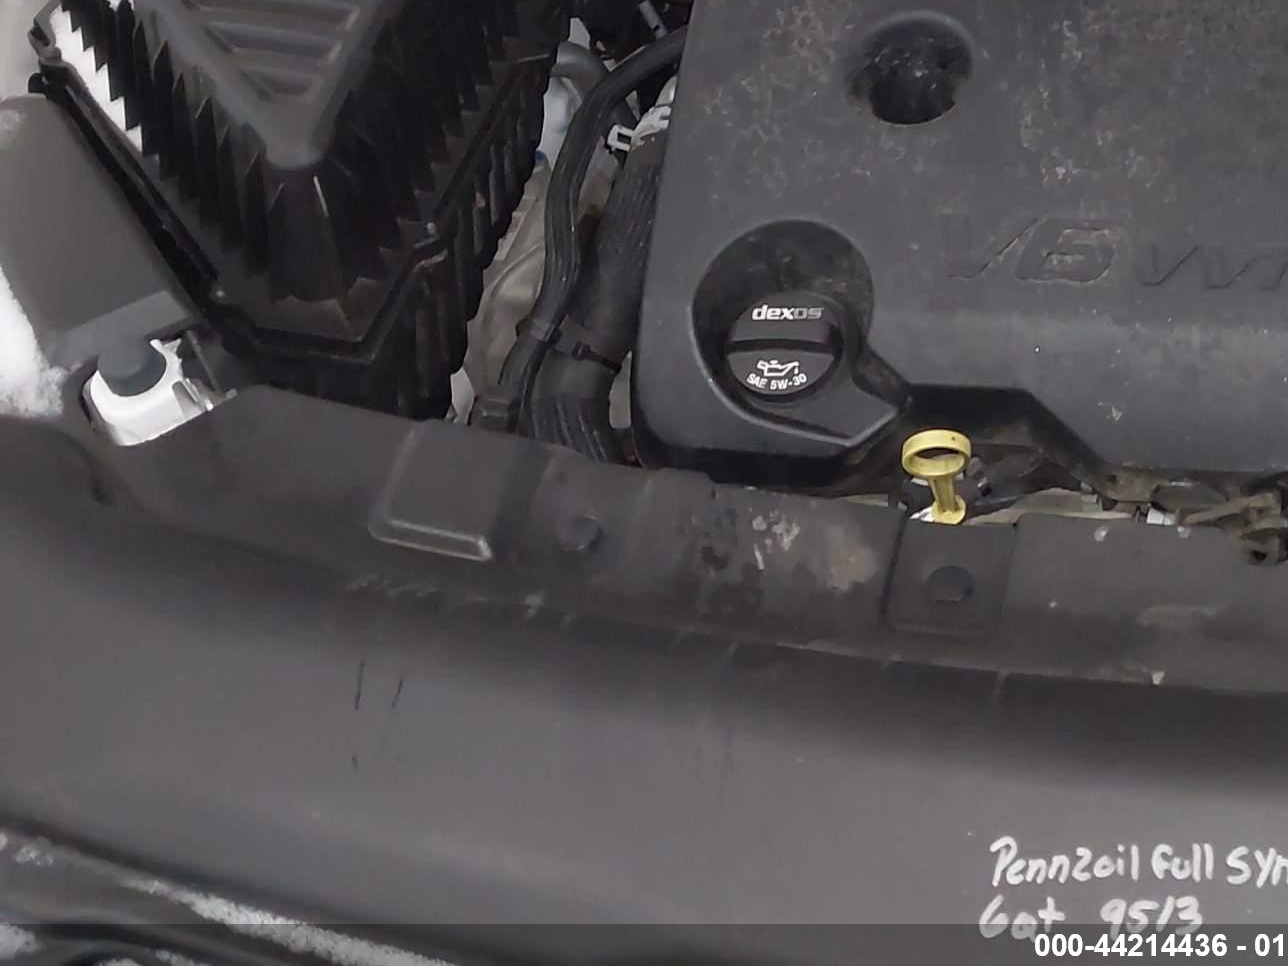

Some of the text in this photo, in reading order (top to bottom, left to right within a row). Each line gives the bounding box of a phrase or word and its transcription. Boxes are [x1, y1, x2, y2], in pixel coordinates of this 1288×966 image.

[752, 304, 824, 321] dexos
[746, 373, 808, 390] SAE 5W-30
[1099, 895, 1204, 941] 9513
